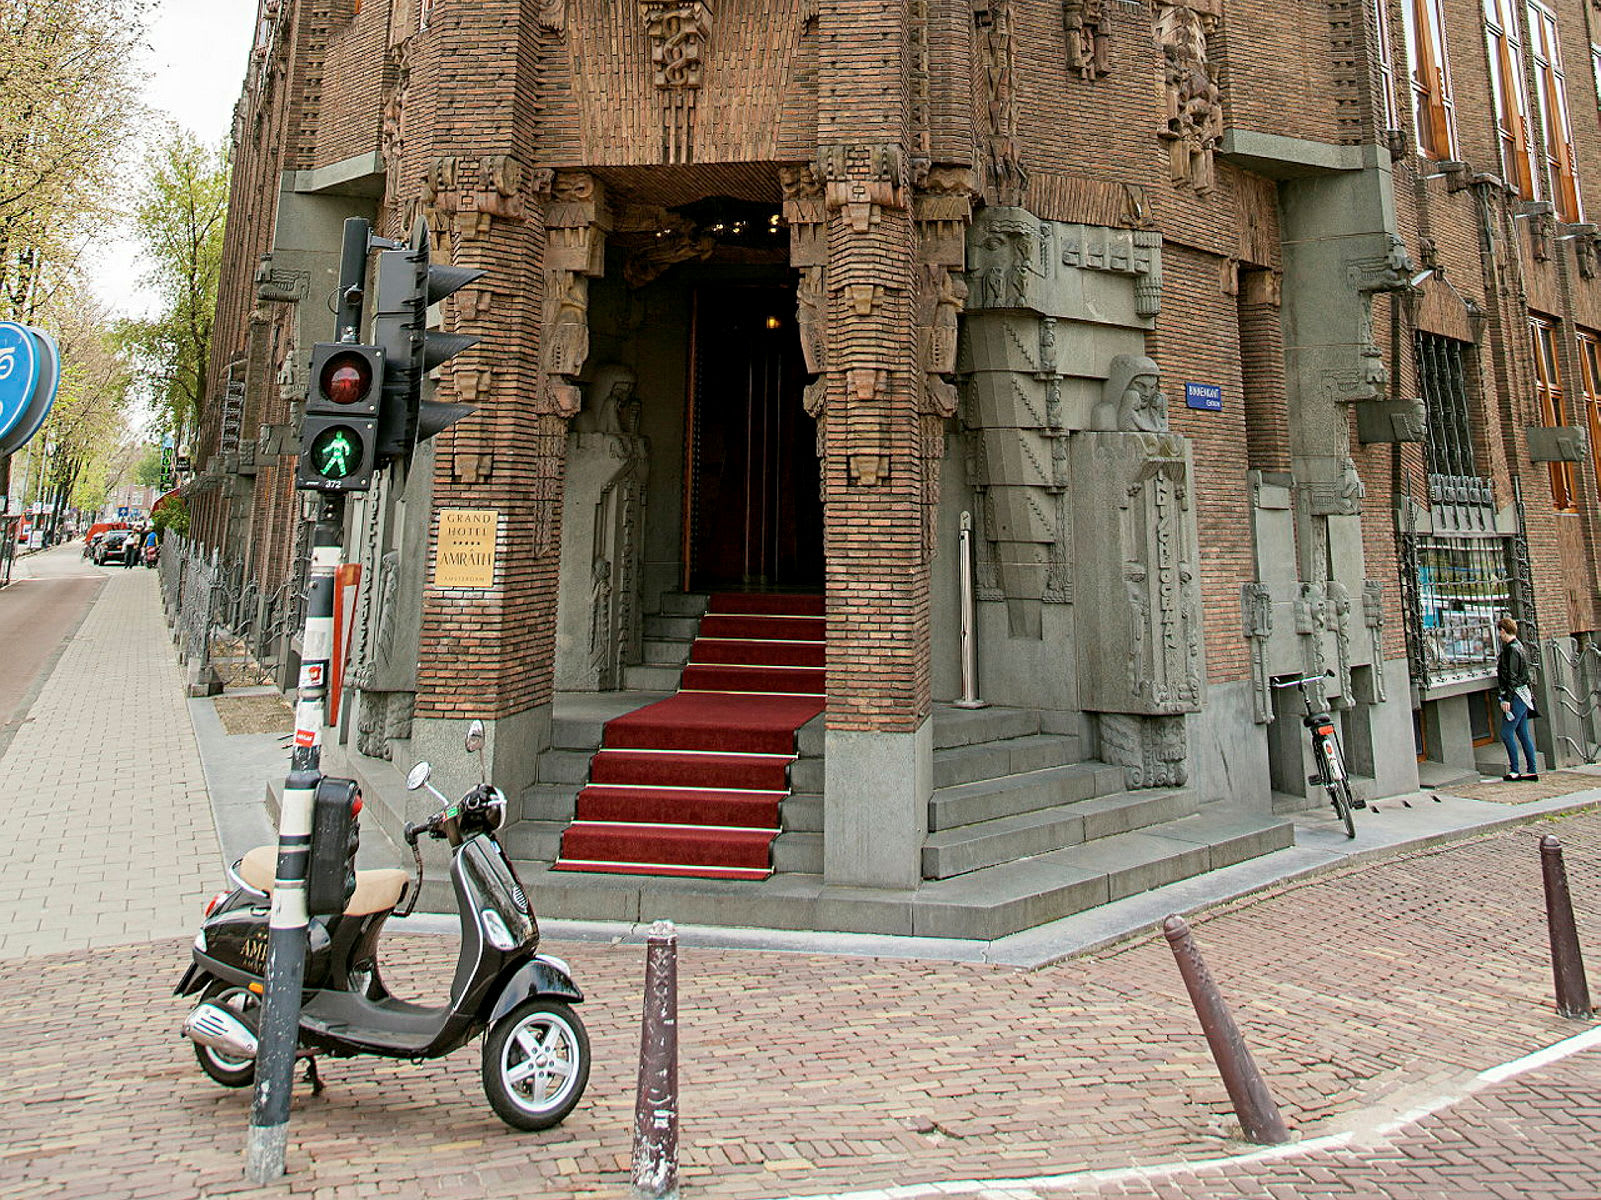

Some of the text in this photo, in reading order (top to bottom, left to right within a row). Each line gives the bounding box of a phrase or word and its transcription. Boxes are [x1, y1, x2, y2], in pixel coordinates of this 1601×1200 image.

[325, 480, 342, 489] 372
[447, 513, 492, 524] GRAND
[448, 527, 487, 537] HOTEL
